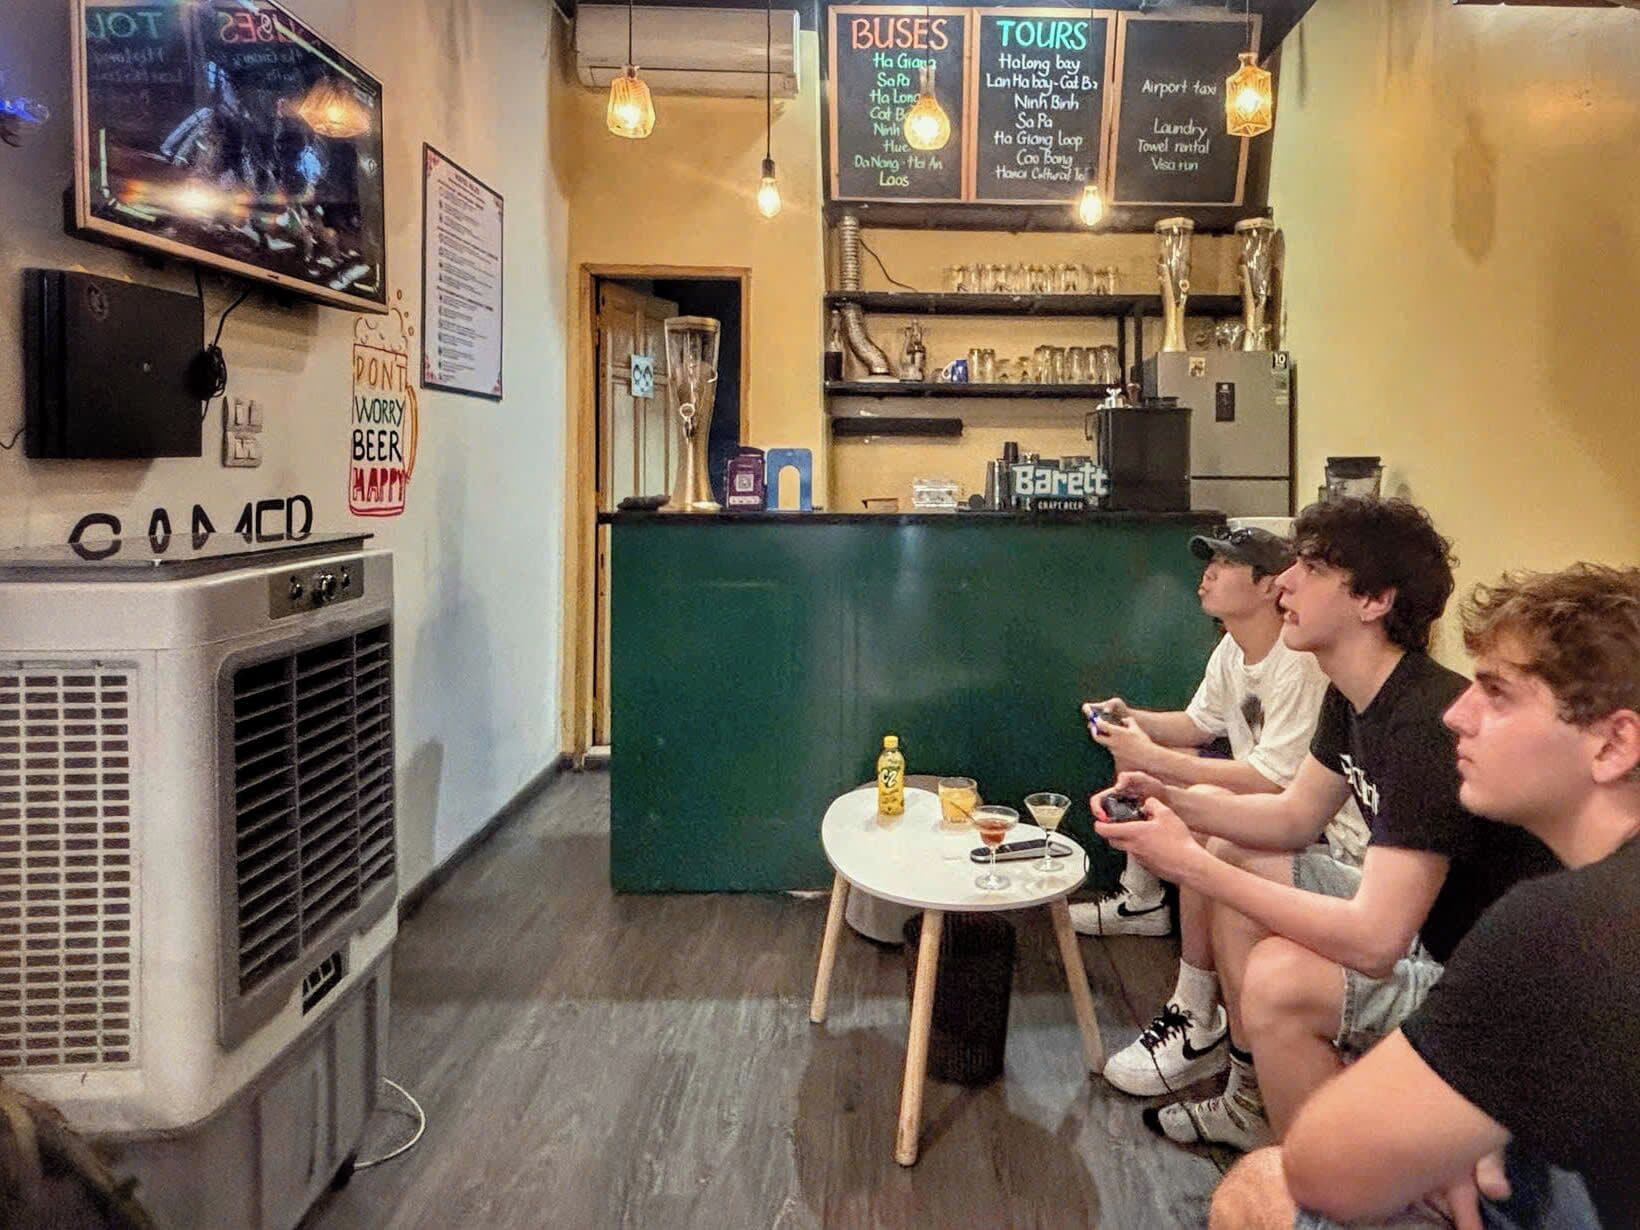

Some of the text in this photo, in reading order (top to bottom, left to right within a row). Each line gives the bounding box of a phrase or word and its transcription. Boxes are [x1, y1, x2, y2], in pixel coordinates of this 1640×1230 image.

[851, 17, 949, 51] BUSES
[996, 20, 1089, 51] TOURS
[873, 52, 894, 69] Ha
[1055, 54, 1081, 76] bay
[869, 88, 890, 105] Ha
[1141, 80, 1217, 99] Airport taxi
[1014, 93, 1080, 110] Ninh Binh
[869, 106, 892, 120] Cat
[1037, 112, 1054, 129] Pa
[1153, 117, 1208, 141] Laundry
[994, 130, 1013, 145] Ha
[1016, 130, 1055, 151] Giang
[1138, 137, 1169, 153] Towel
[1151, 156, 1176, 171] Visa
[879, 170, 910, 187] Laos
[354, 396, 405, 427] WORRY
[352, 428, 402, 463] BEER
[352, 467, 403, 502] HAPPY
[1012, 462, 1108, 496] Barett
[880, 768, 898, 788] C2
